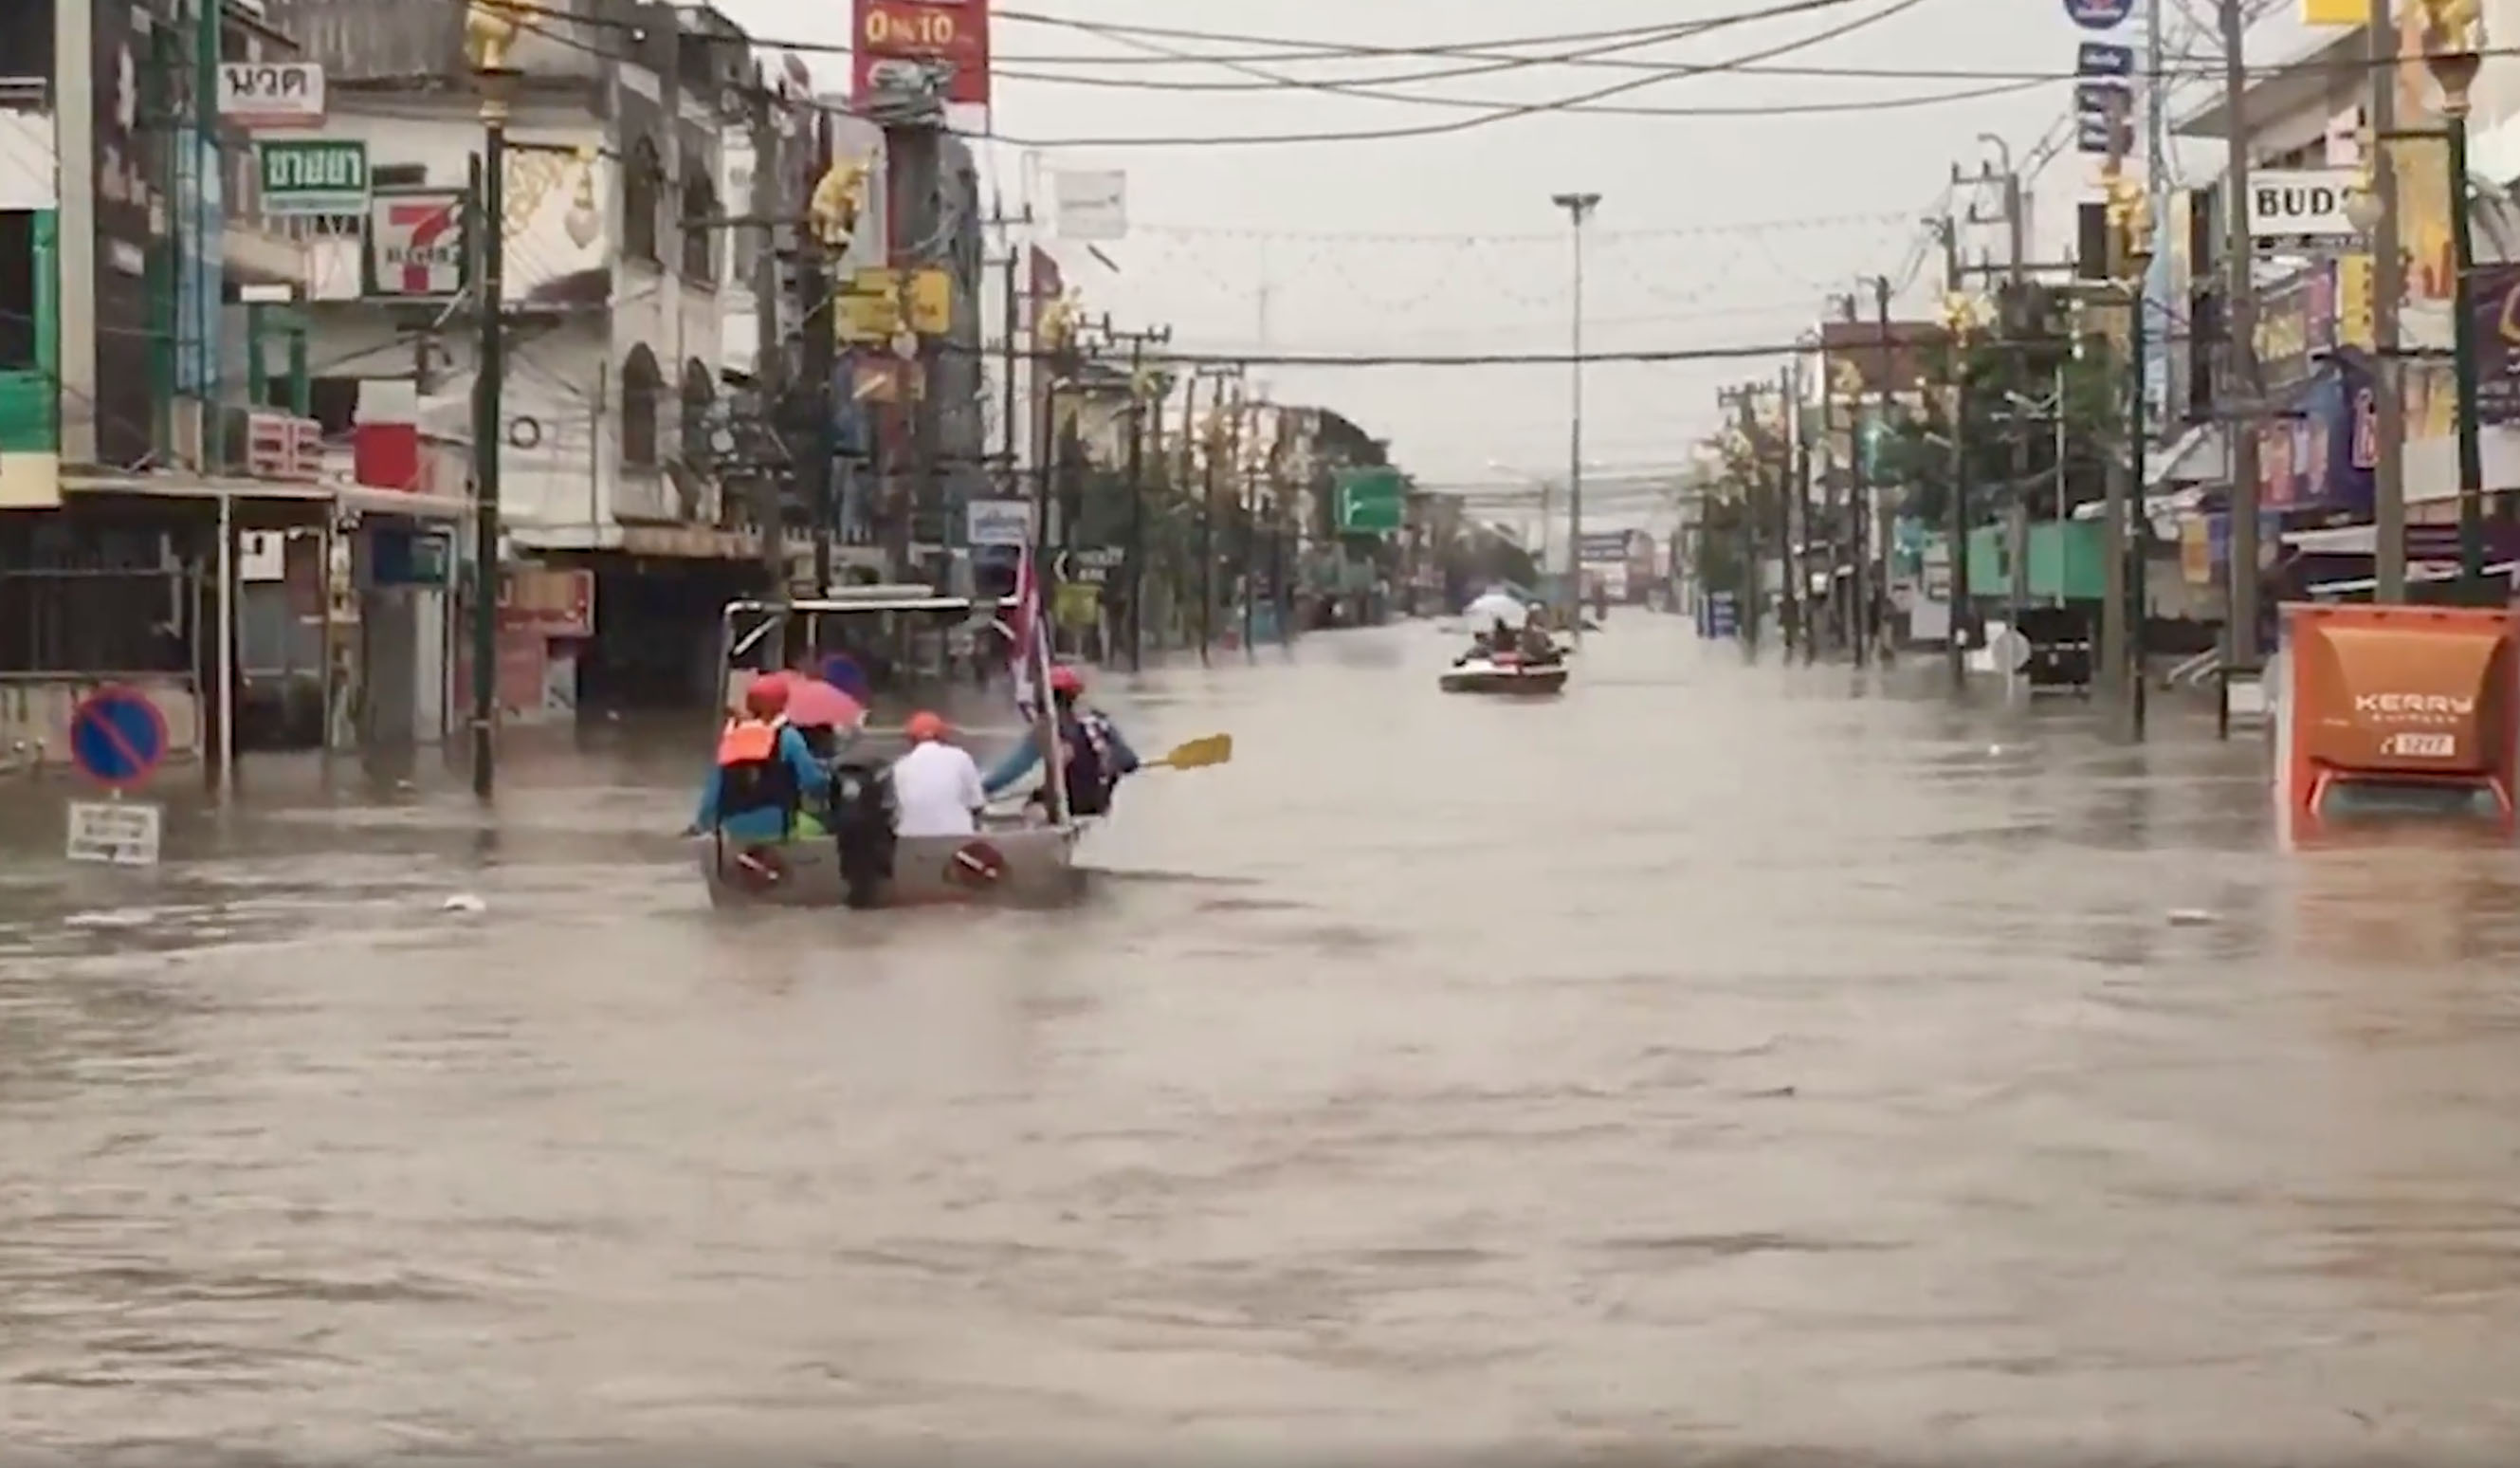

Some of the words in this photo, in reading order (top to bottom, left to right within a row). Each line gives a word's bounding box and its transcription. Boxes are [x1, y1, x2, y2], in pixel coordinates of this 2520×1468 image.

[226, 66, 307, 96] นวด
[267, 148, 362, 187] ขายยา
[2354, 693, 2474, 713] KERRY
